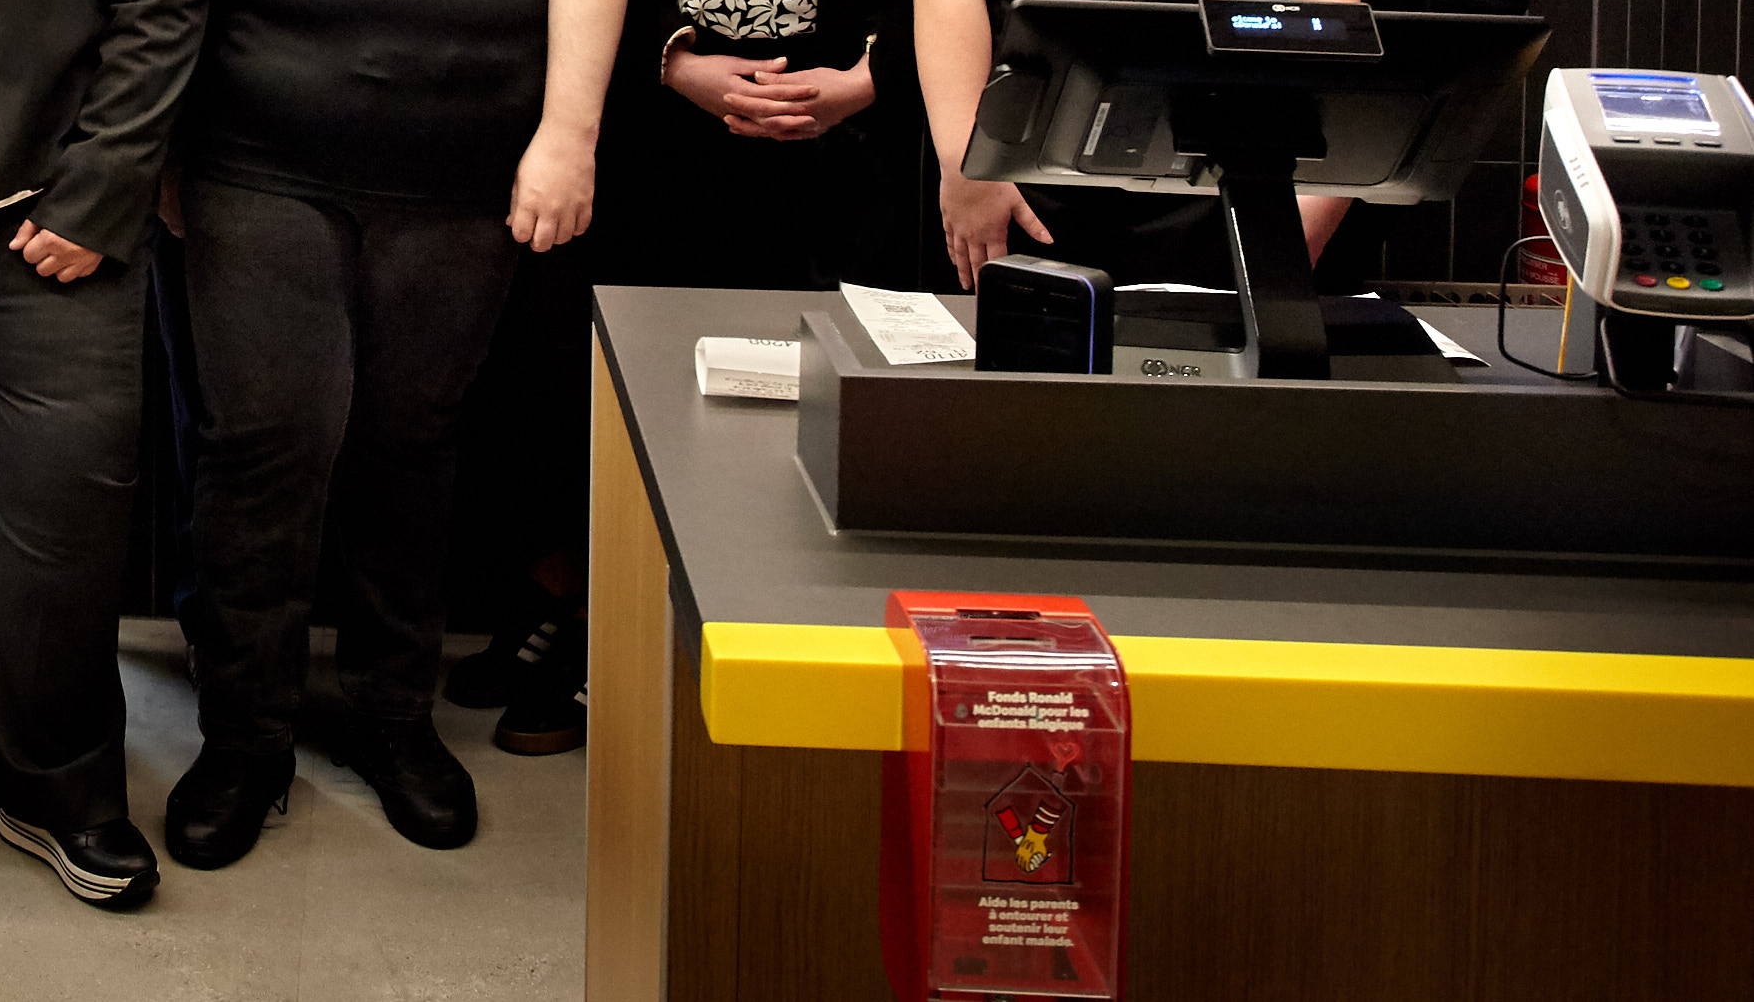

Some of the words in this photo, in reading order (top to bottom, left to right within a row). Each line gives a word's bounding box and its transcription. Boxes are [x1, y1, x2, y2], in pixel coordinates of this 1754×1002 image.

[988, 691, 1026, 703] Fonds
[1028, 692, 1073, 704] Ronald
[973, 704, 1037, 716] McDonald
[1038, 708, 1068, 719] pour
[1070, 706, 1089, 717] les
[978, 718, 1027, 728] enfants
[1029, 719, 1084, 732] Belgique
[978, 897, 1007, 907] Aide
[1009, 898, 1028, 908] les
[1030, 900, 1079, 910] parents
[999, 910, 1053, 921] entourer
[1054, 912, 1069, 922] et
[988, 923, 1041, 933] soutenir
[1043, 923, 1068, 934] leur
[982, 934, 1024, 945] enfant
